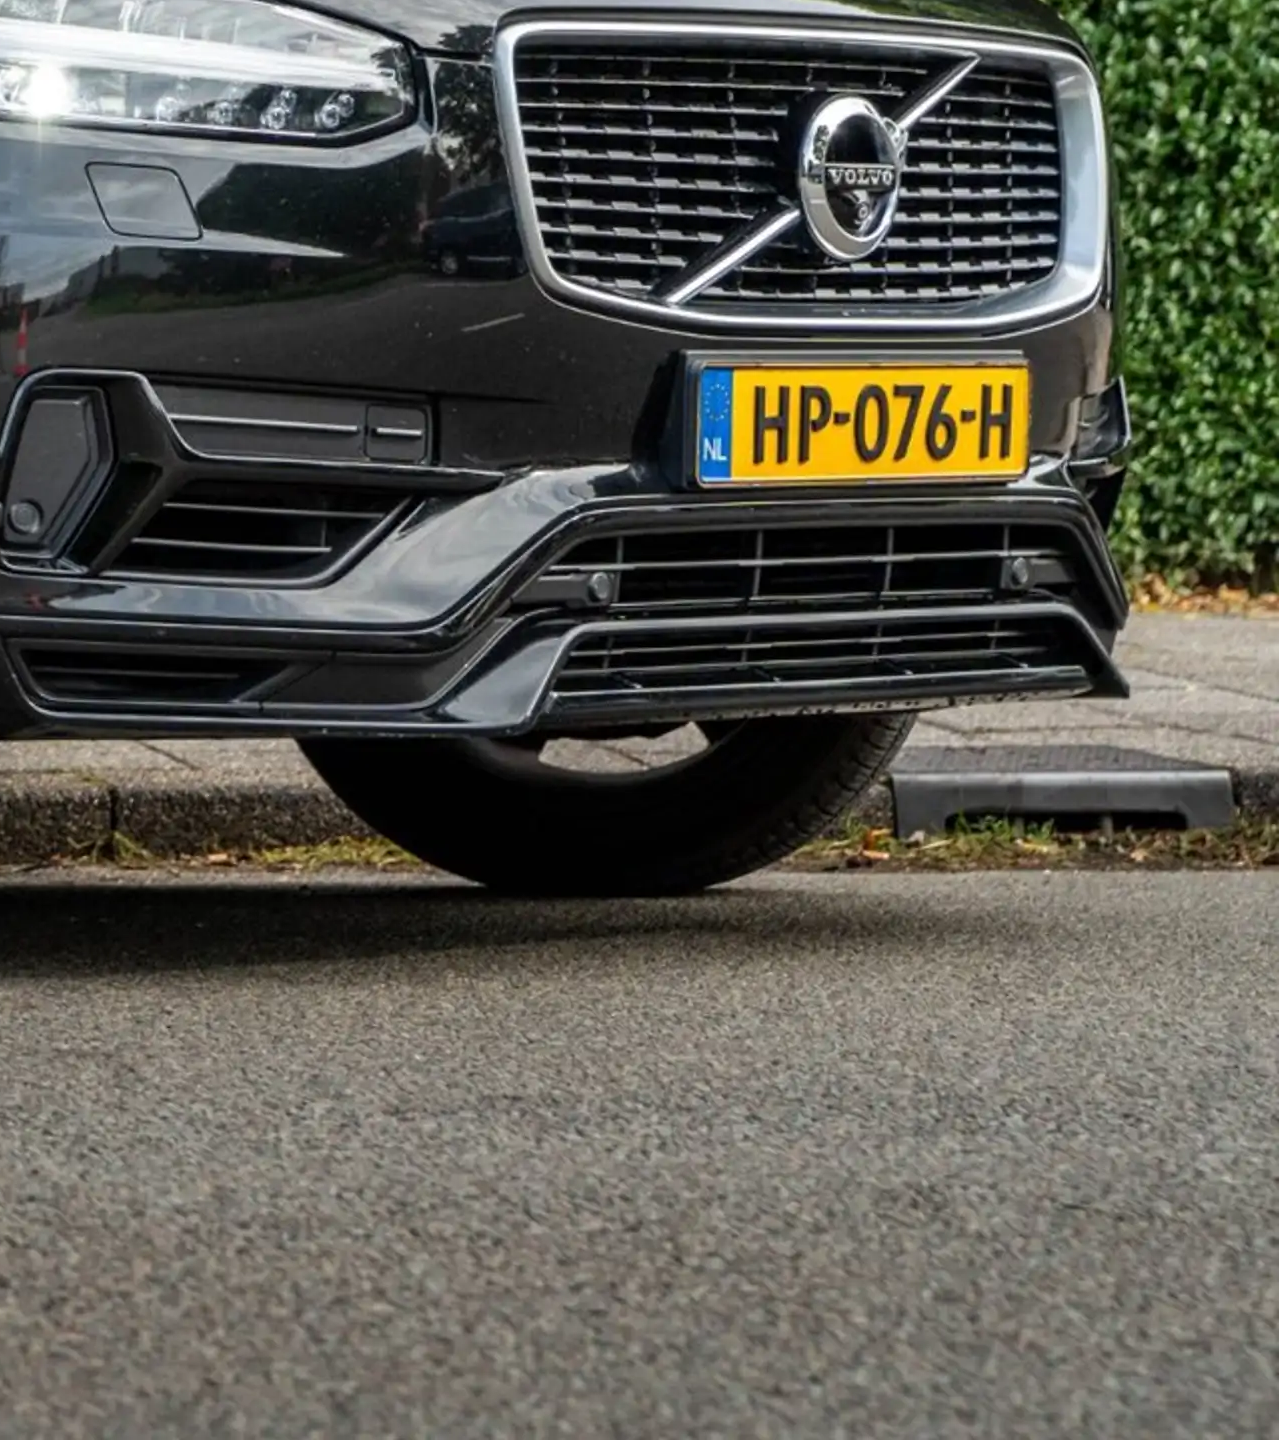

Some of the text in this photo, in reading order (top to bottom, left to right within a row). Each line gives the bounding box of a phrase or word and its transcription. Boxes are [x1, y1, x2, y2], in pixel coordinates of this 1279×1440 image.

[827, 167, 895, 186] VOLVO
[752, 383, 1014, 466] HP-076-H
[702, 435, 728, 462] NL
